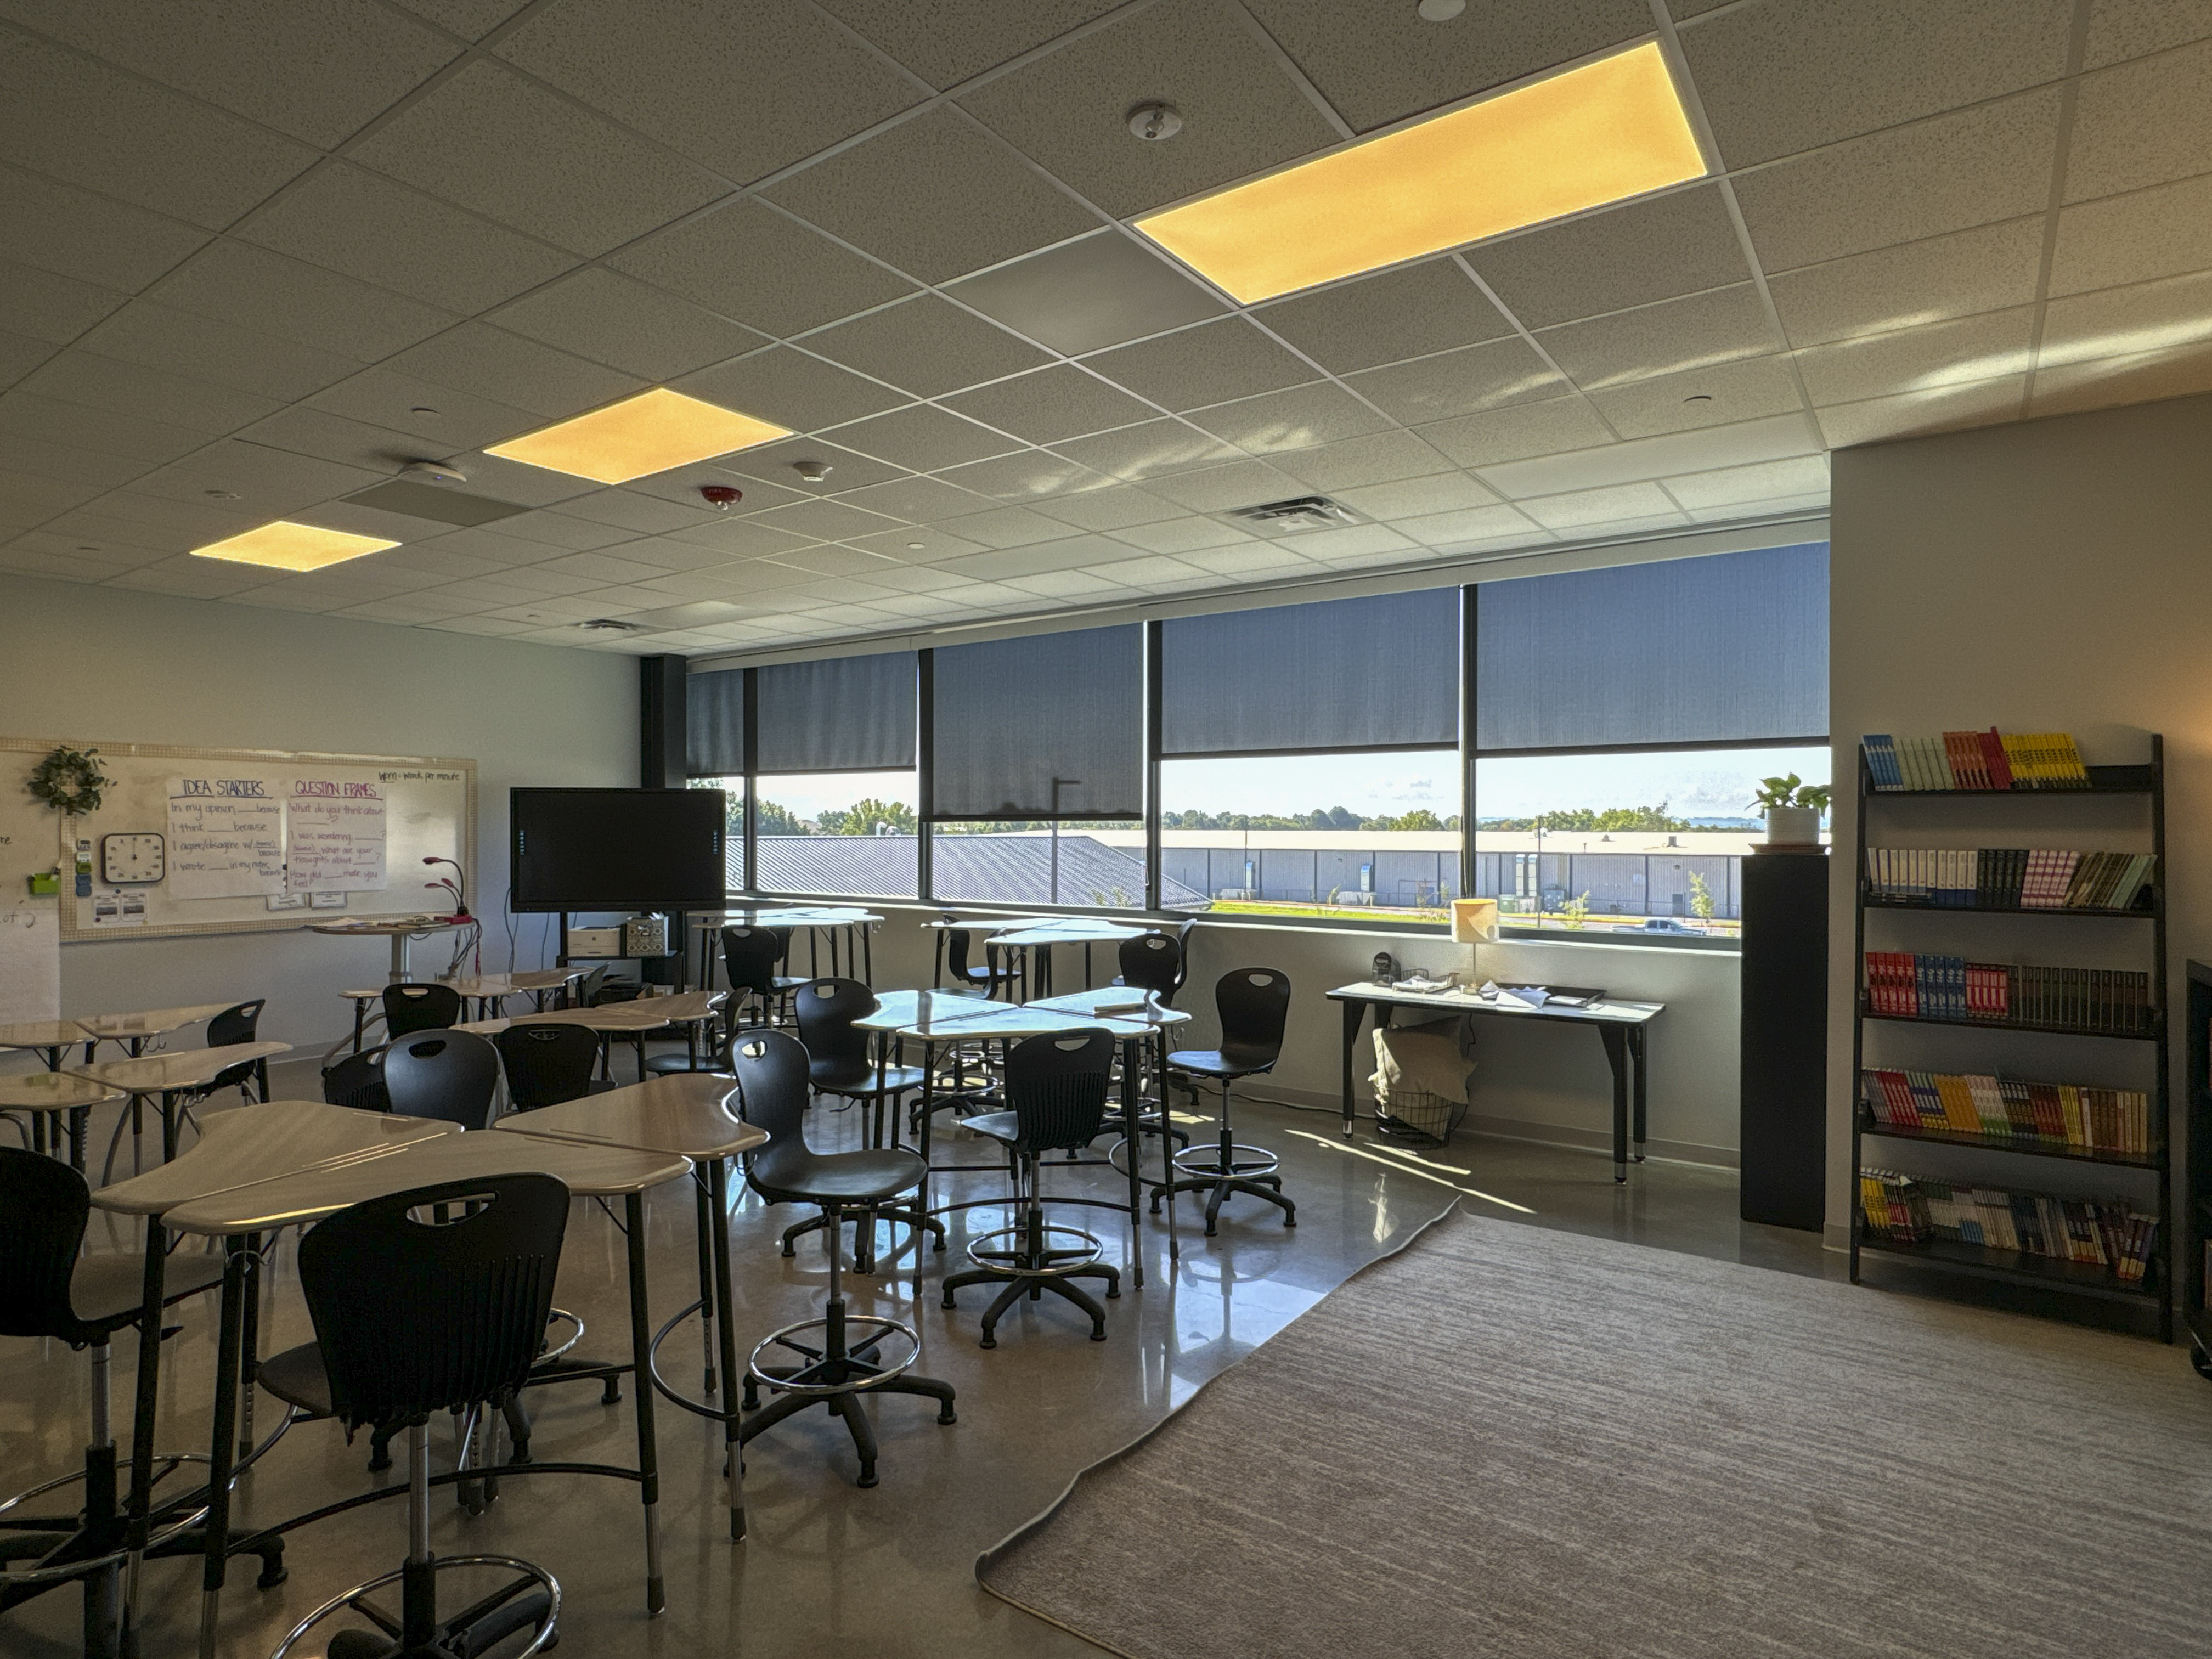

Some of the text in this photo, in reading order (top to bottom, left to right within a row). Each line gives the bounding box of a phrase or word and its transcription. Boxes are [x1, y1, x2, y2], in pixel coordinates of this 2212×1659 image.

[425, 772, 435, 783] per
[437, 772, 460, 781] minute
[183, 780, 264, 795] IDEA STARTERS
[295, 780, 376, 797] QUESTION FRAMES
[172, 802, 182, 812] In
[185, 804, 202, 821] my
[289, 803, 385, 820] What do you think about
[172, 821, 267, 833] I think because
[173, 840, 176, 851] I
[173, 861, 176, 870] I
[180, 862, 205, 871] wrote
[239, 862, 251, 872] my
